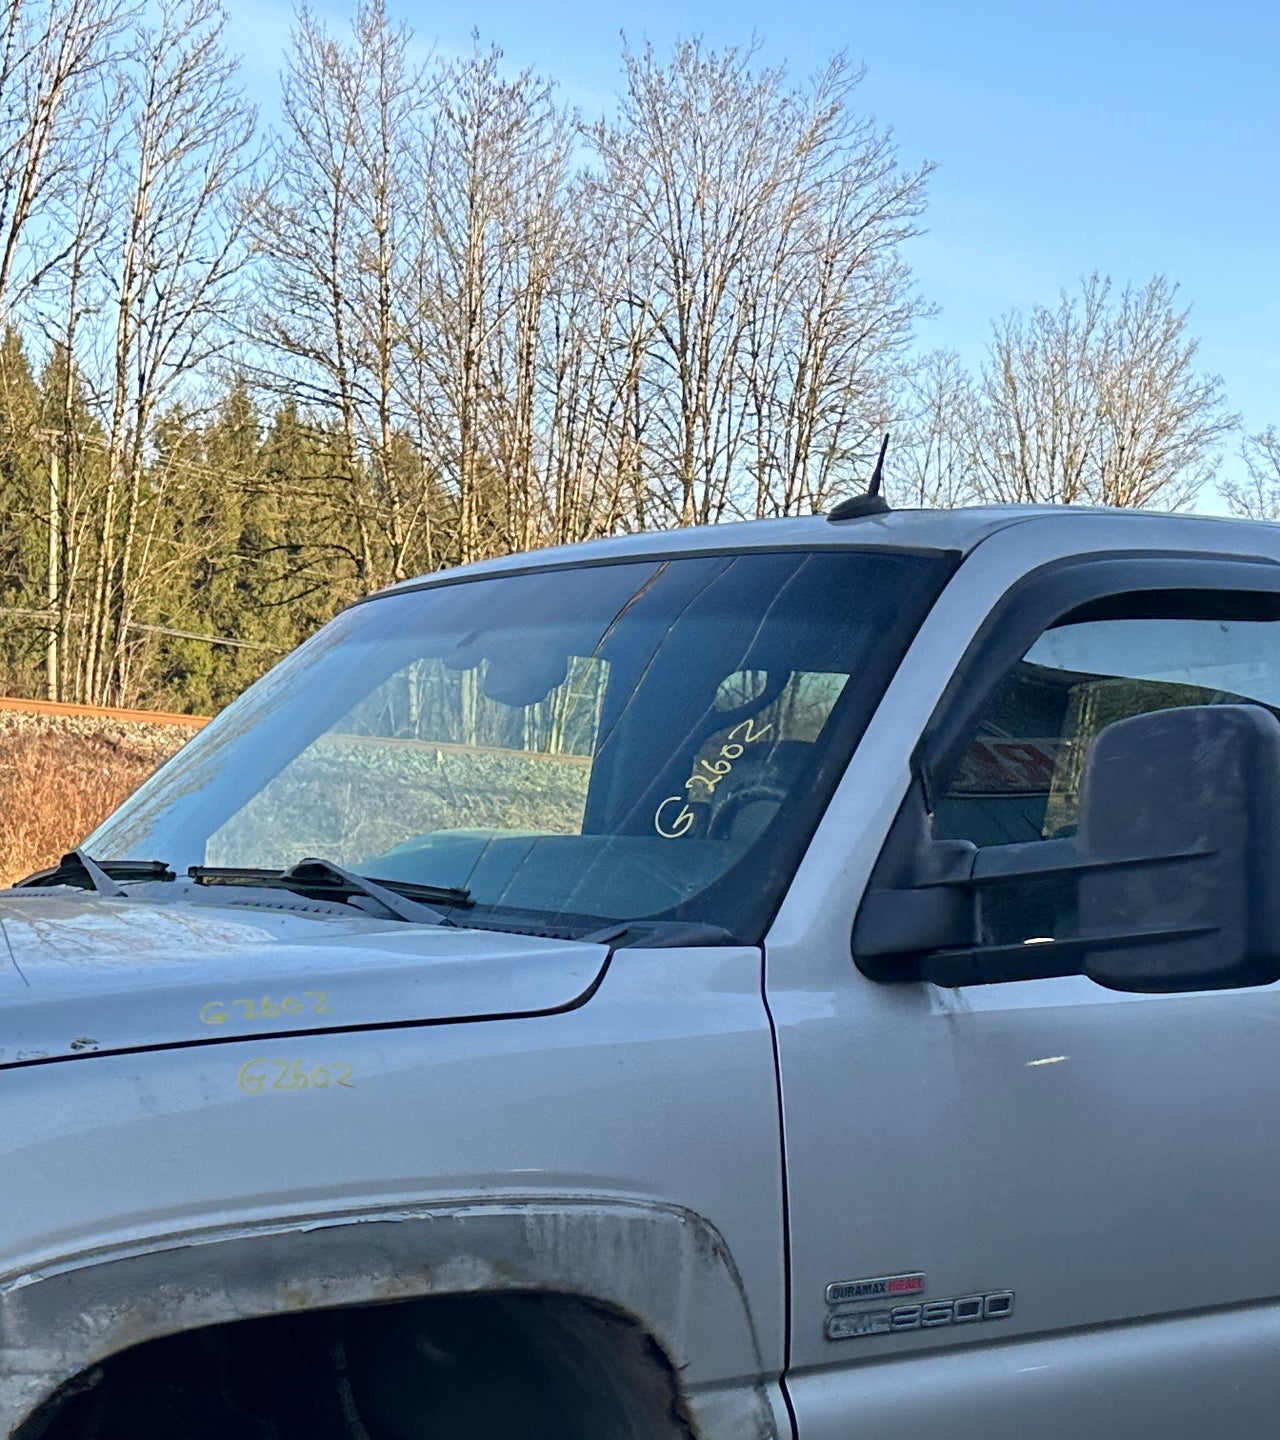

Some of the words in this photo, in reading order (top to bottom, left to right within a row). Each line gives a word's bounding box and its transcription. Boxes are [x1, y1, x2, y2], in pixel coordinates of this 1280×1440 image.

[238, 1057, 356, 1095] G2602
[831, 1280, 887, 1300] DURAMAX
[891, 1291, 1015, 1331] 3500
